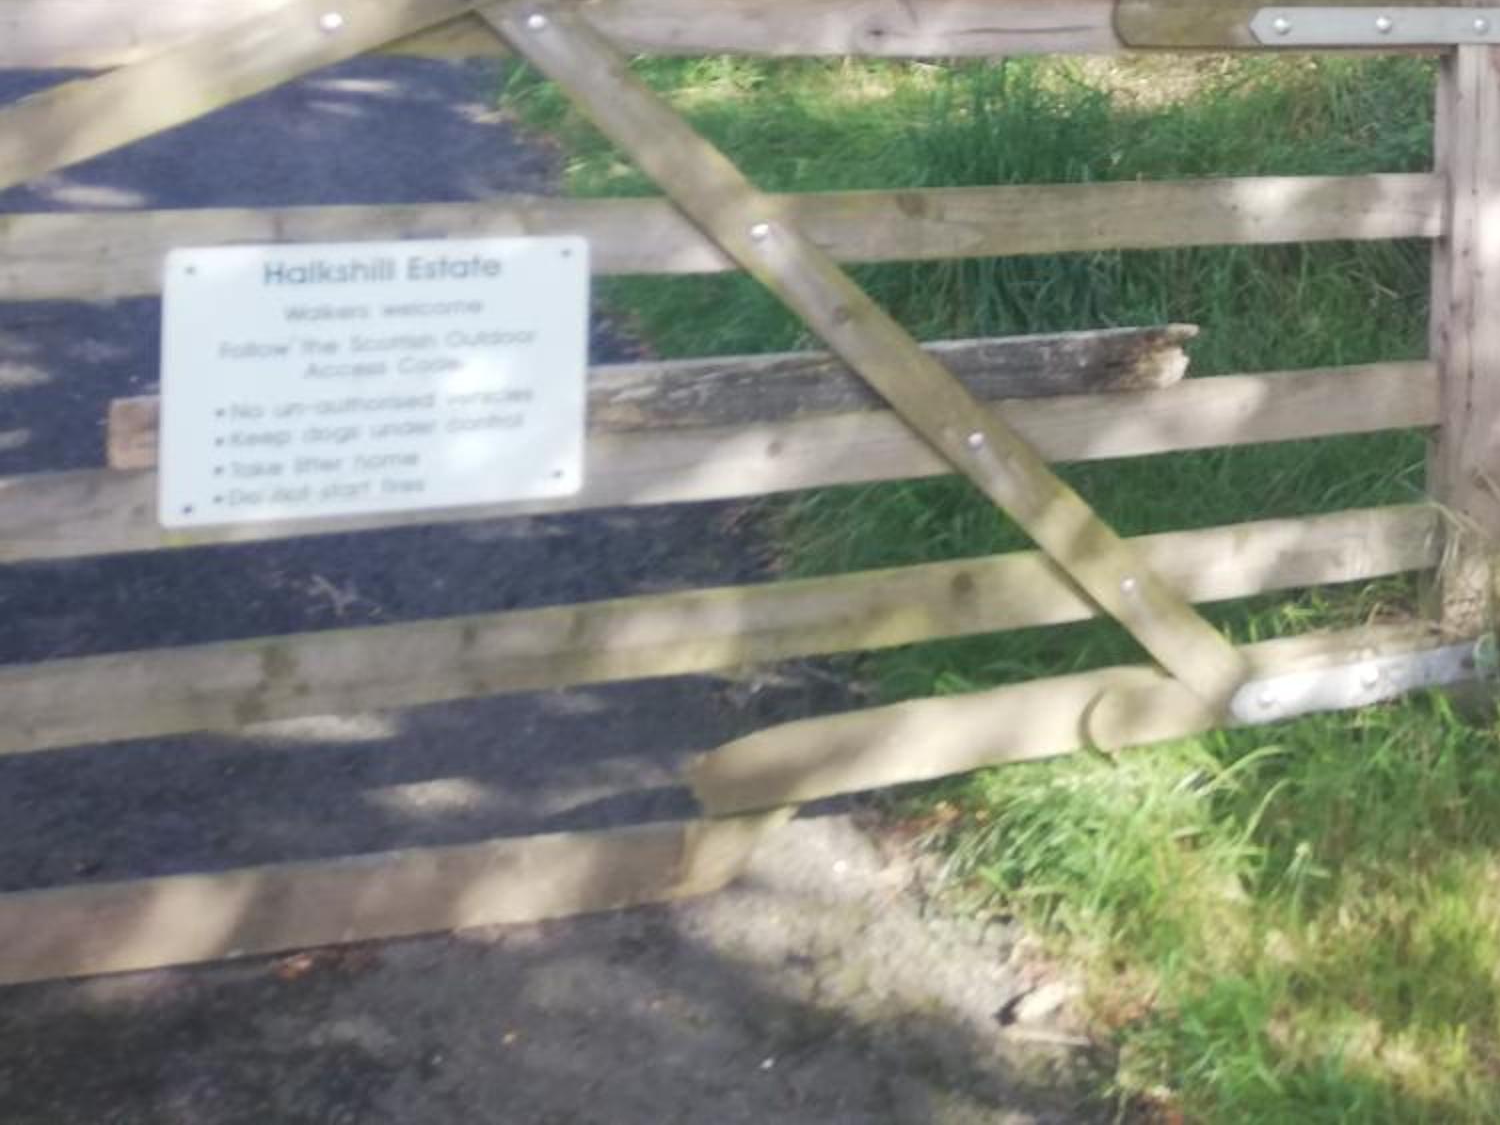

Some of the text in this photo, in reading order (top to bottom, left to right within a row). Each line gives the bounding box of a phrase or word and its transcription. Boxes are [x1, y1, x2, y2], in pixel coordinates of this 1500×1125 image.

[263, 254, 502, 285] Halkshill Estate
[382, 300, 483, 316] welcome
[219, 329, 538, 359] Follow the Scottish Outdoor
[304, 359, 387, 379] Access
[231, 401, 265, 419] No
[231, 414, 524, 448] Keep dogs under control
[230, 458, 284, 476] Take
[354, 452, 420, 468] home
[228, 488, 262, 506] Do
